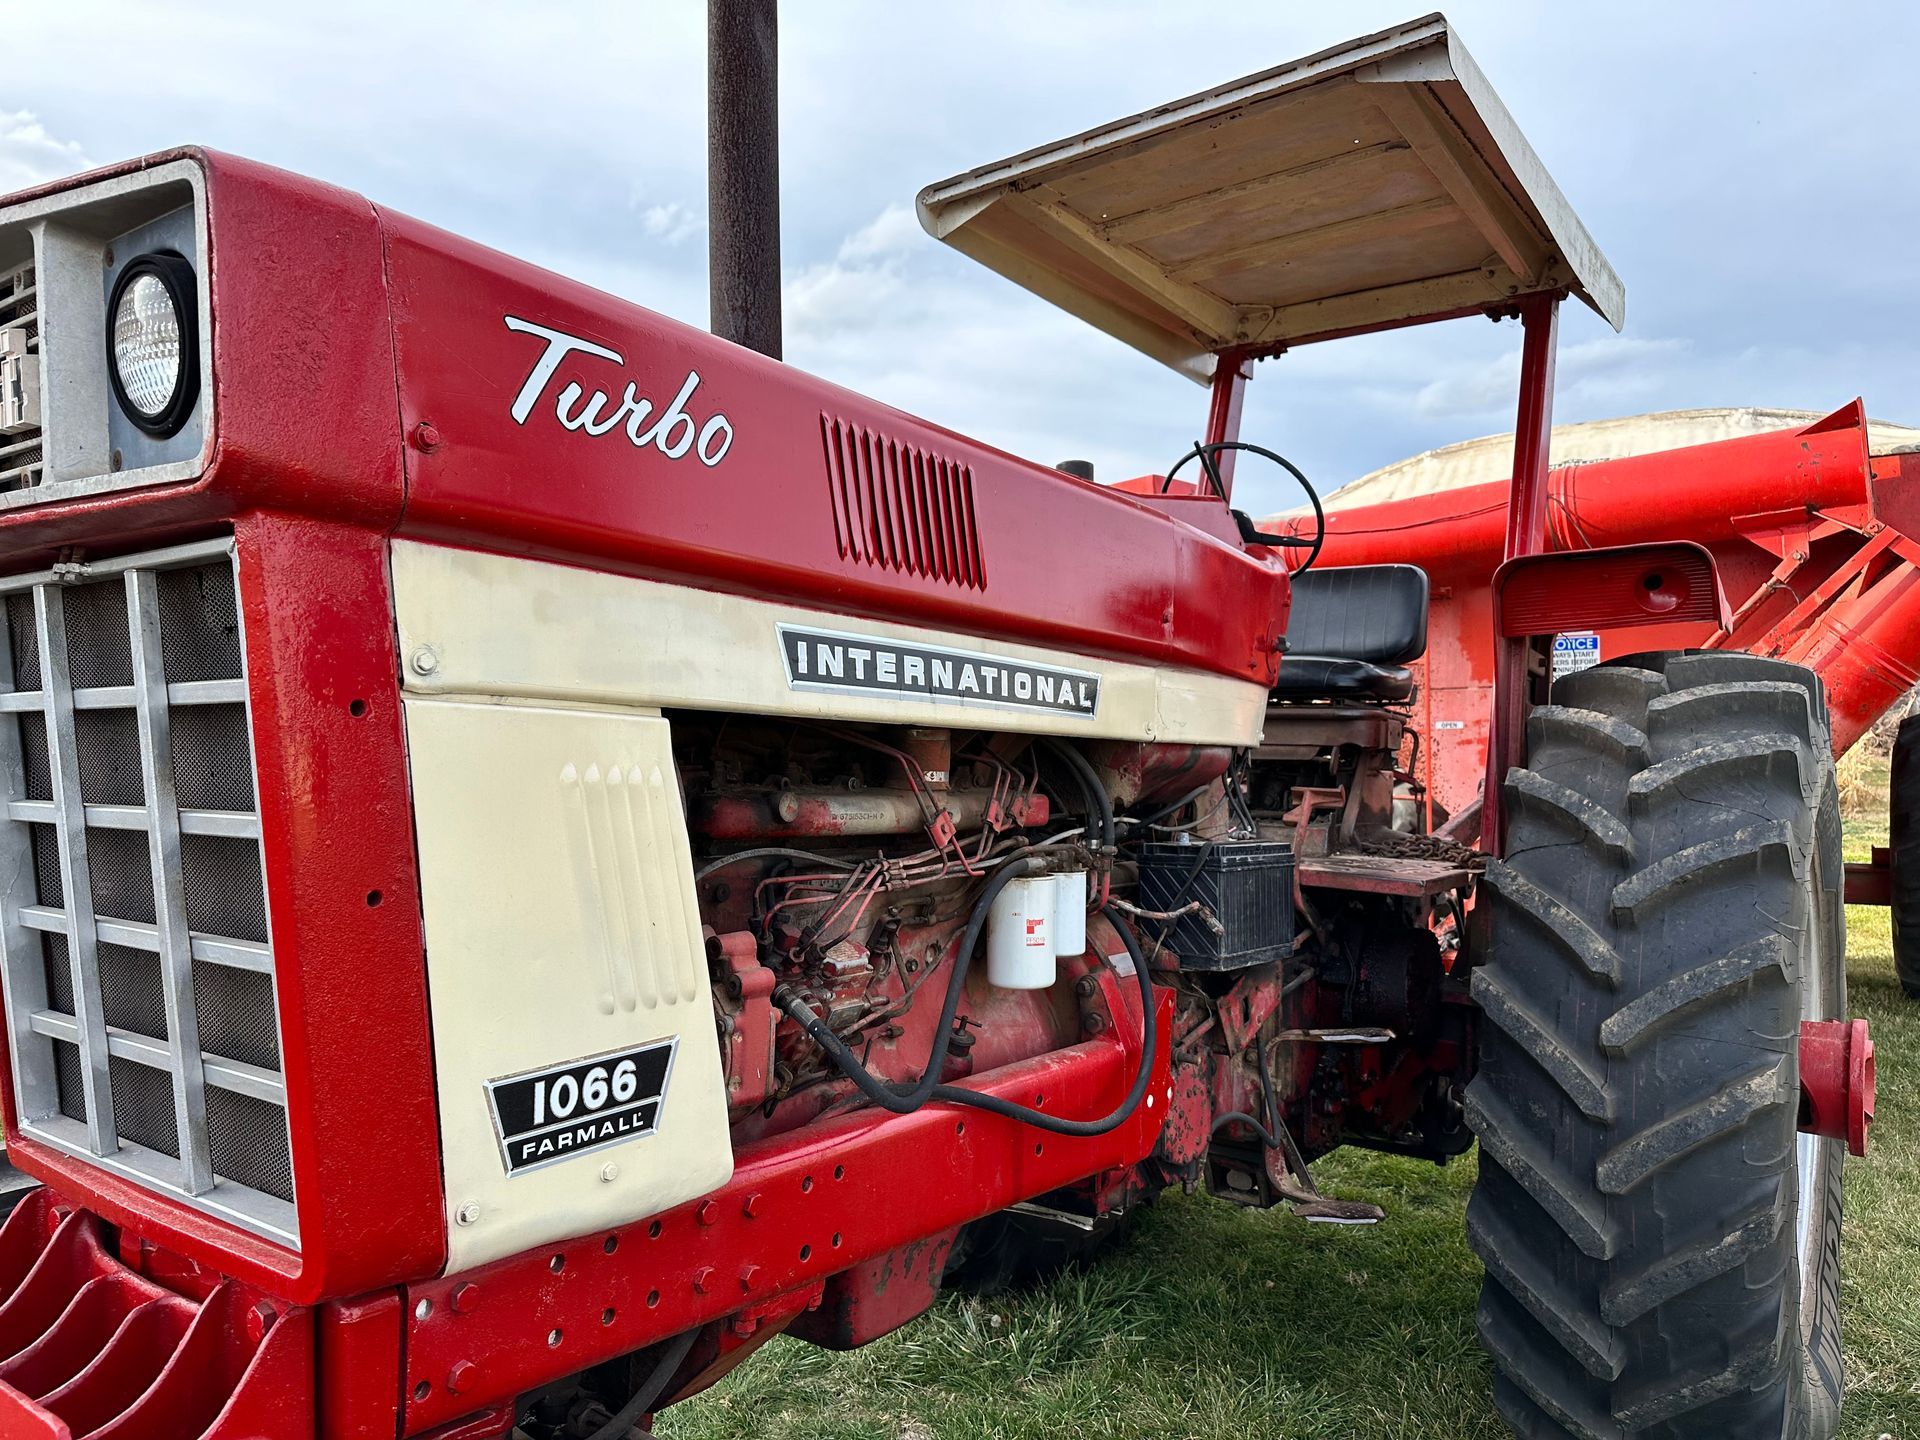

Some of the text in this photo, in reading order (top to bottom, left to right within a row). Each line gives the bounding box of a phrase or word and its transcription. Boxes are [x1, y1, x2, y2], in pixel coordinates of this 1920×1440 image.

[504, 315, 734, 467] Turbo
[797, 641, 1092, 708] INTERNATIONAL
[1554, 638, 1594, 650] OTICE
[533, 1059, 637, 1126] 1066
[522, 1113, 644, 1160] FARMALL
[1818, 1141, 1843, 1394] MICHELIN
